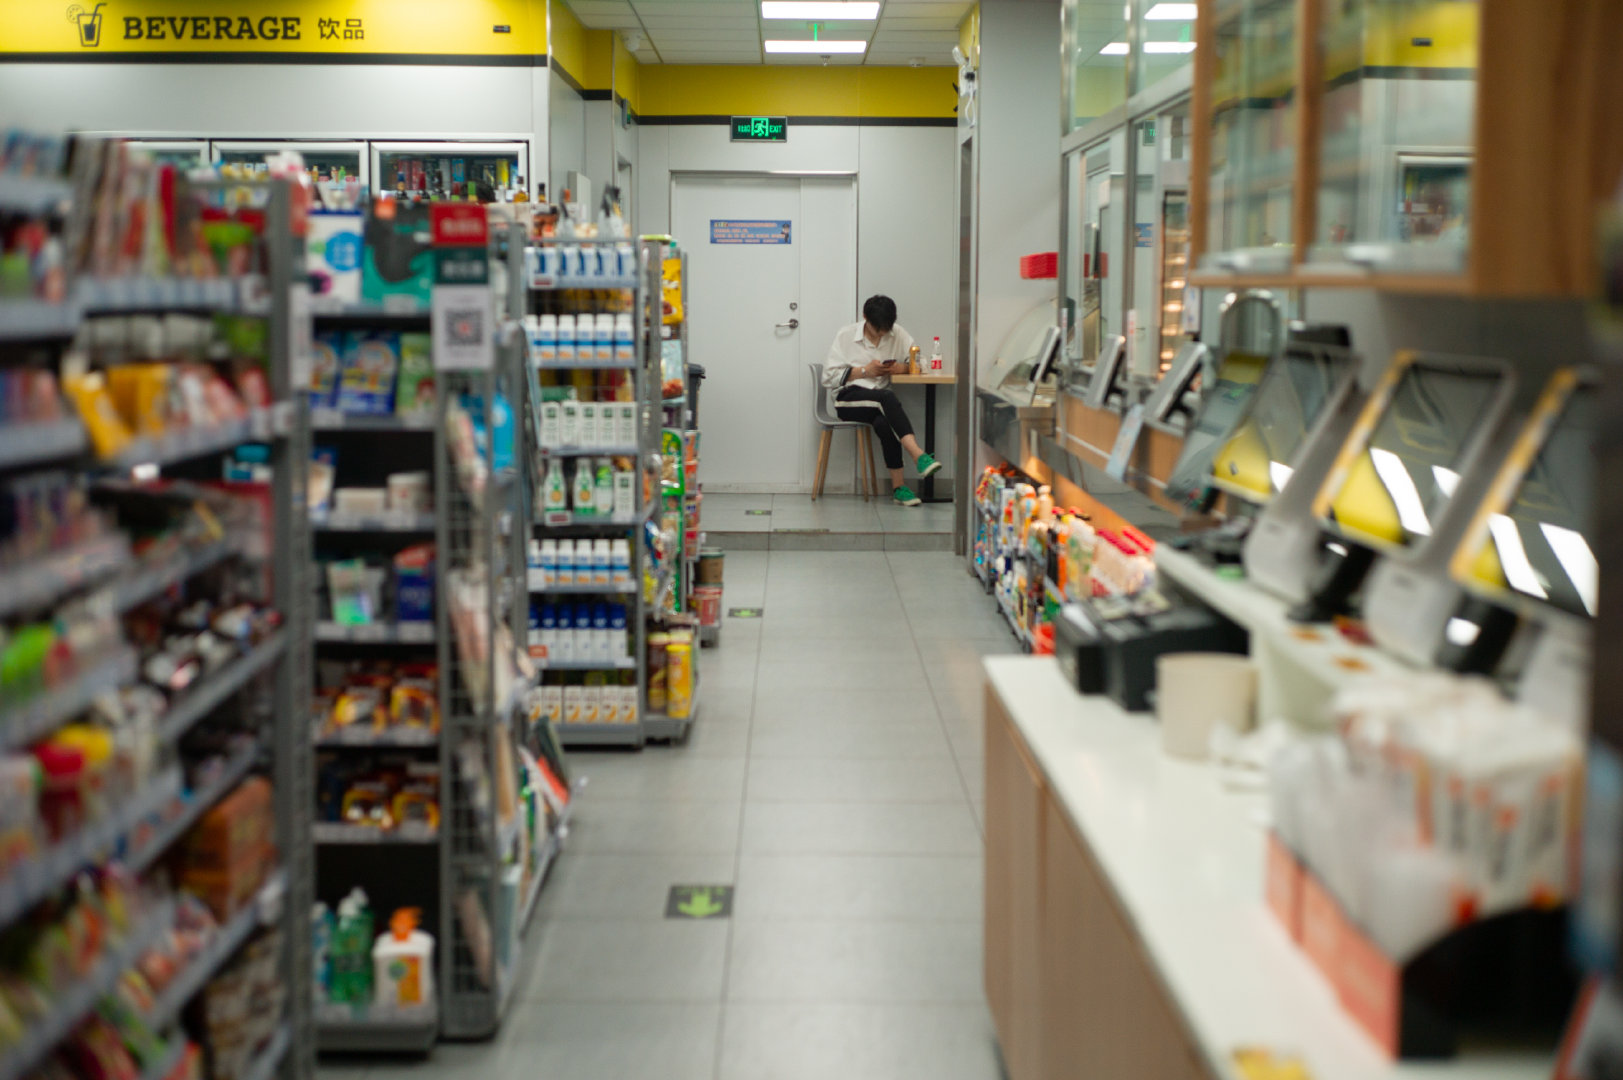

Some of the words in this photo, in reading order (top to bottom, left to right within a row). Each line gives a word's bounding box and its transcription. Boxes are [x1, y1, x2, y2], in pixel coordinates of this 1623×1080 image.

[123, 16, 301, 40] BEVERAGE
[317, 17, 364, 40] 饮品
[769, 125, 783, 133] EXIT
